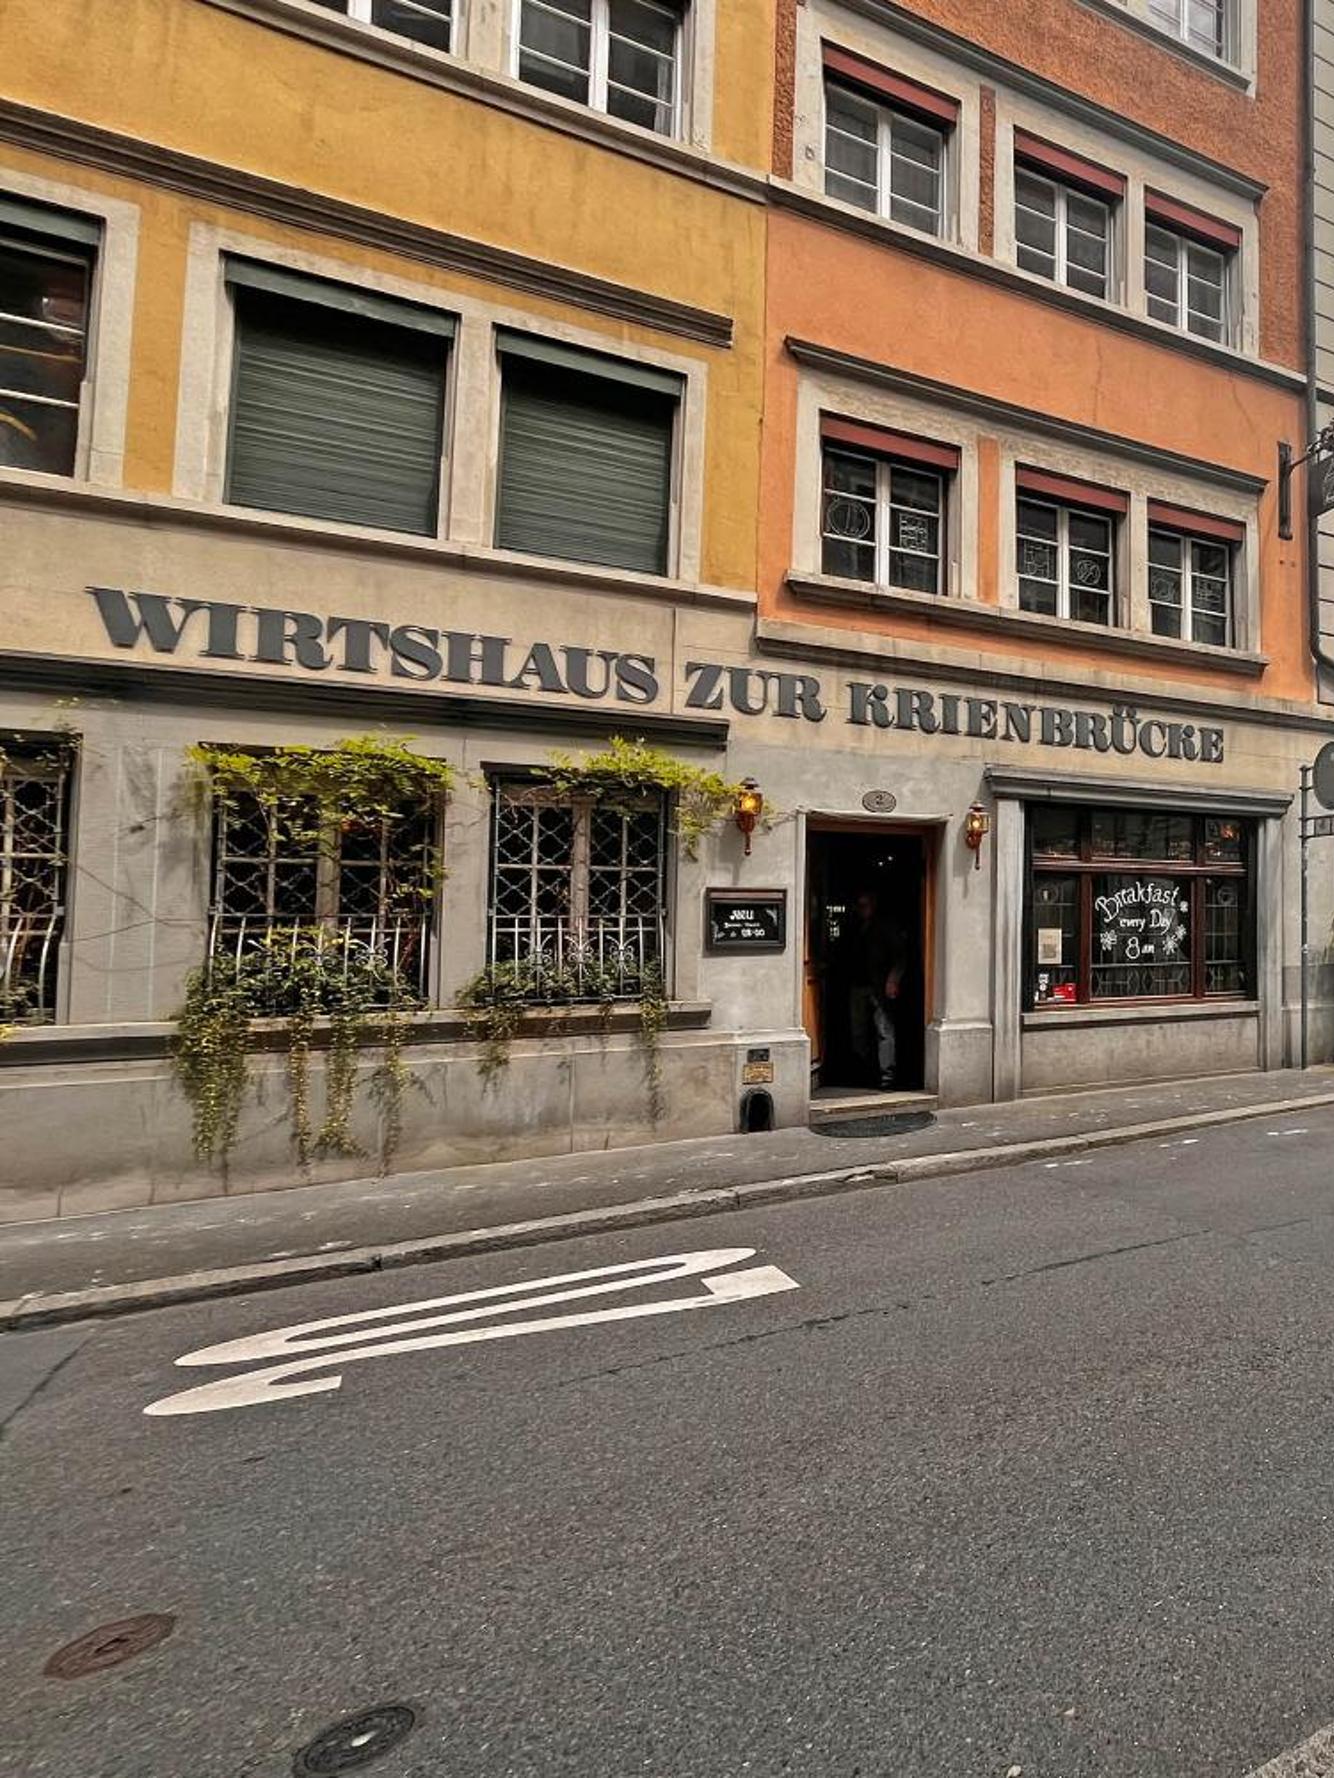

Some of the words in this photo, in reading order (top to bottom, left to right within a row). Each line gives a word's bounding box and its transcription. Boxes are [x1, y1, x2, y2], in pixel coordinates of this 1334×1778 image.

[85, 586, 659, 705] WIRTSHAUS
[685, 661, 828, 722] ZUR
[846, 681, 1225, 764] KRIENBRÜCKE
[1095, 881, 1180, 923] Breakfast
[1125, 936, 1140, 960] 8
